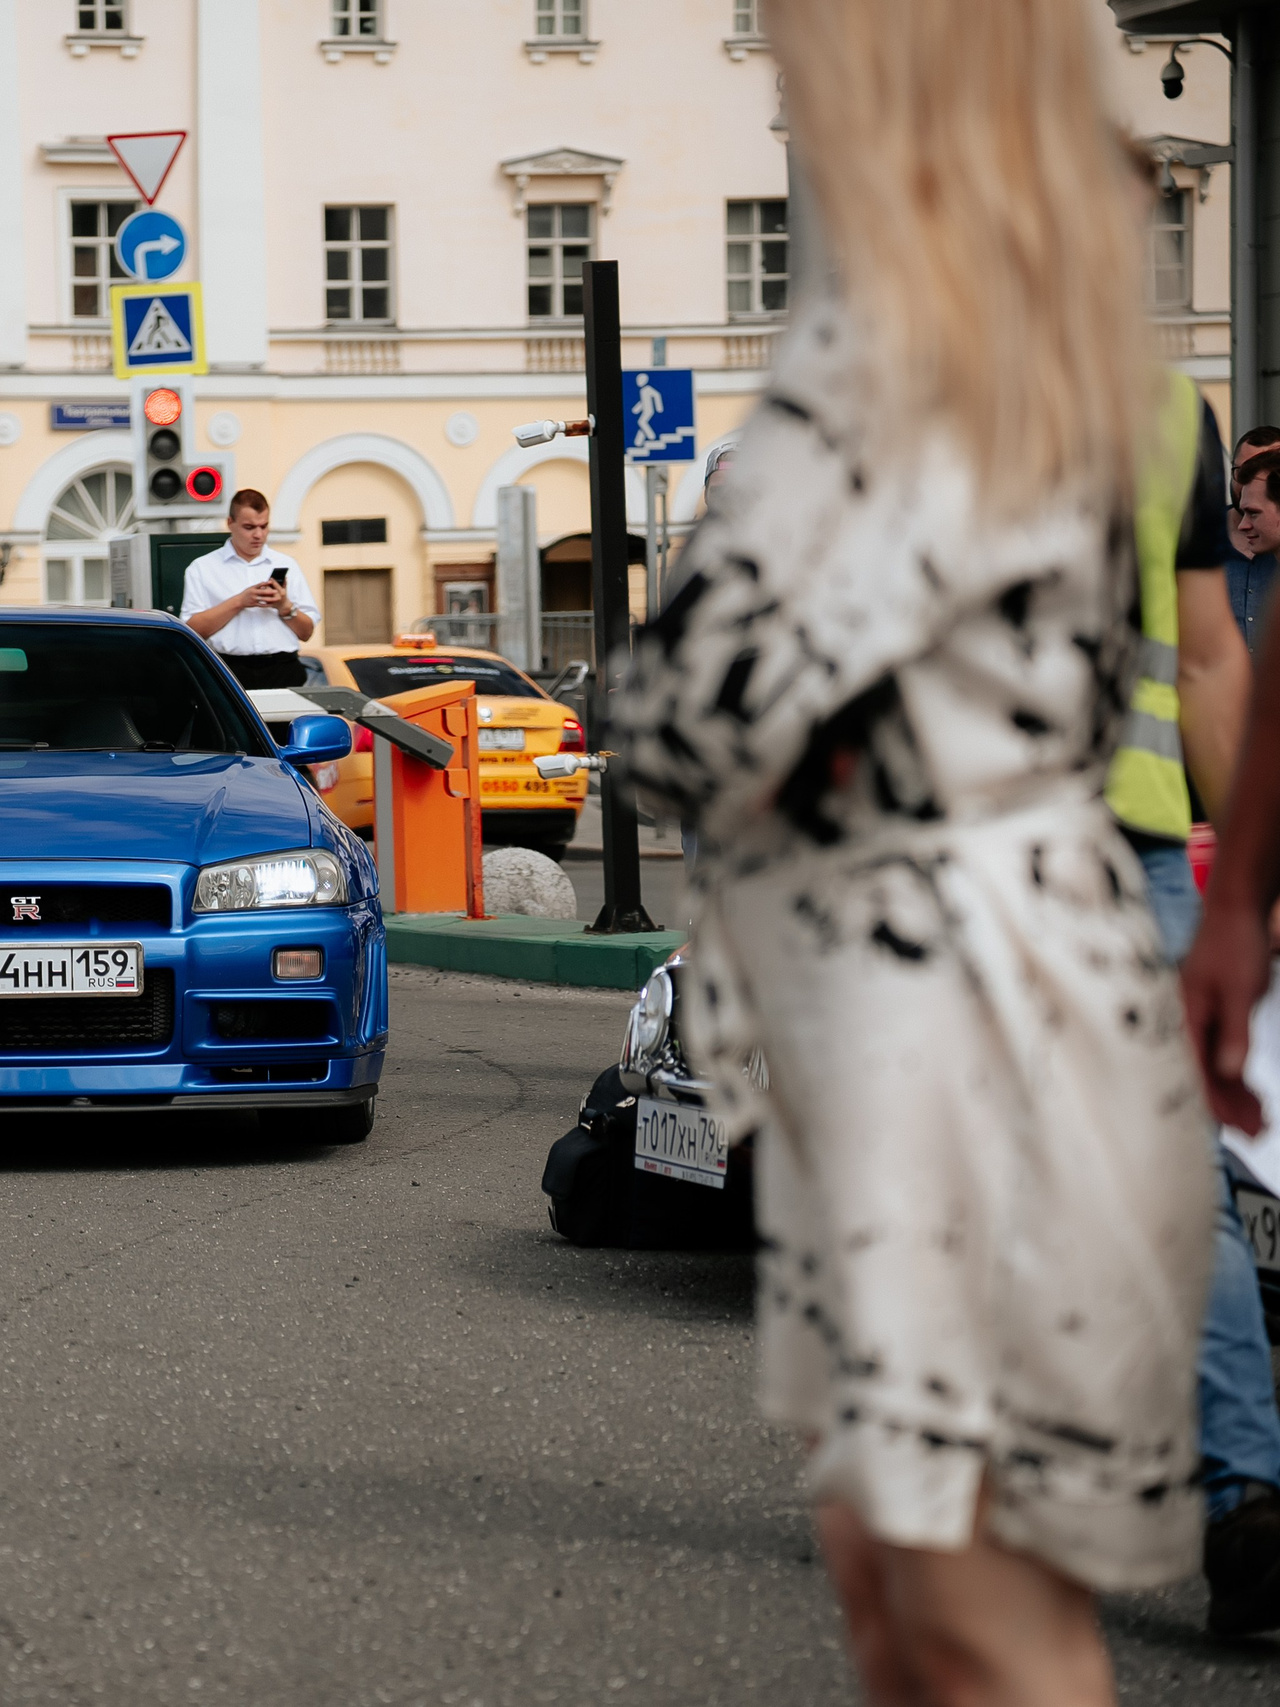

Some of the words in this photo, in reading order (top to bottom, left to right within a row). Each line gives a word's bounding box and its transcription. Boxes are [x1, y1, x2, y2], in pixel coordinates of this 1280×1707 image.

[11, 896, 41, 904] GT
[13, 905, 41, 920] R
[76, 950, 128, 977] 159
[88, 978, 114, 988] RUS
